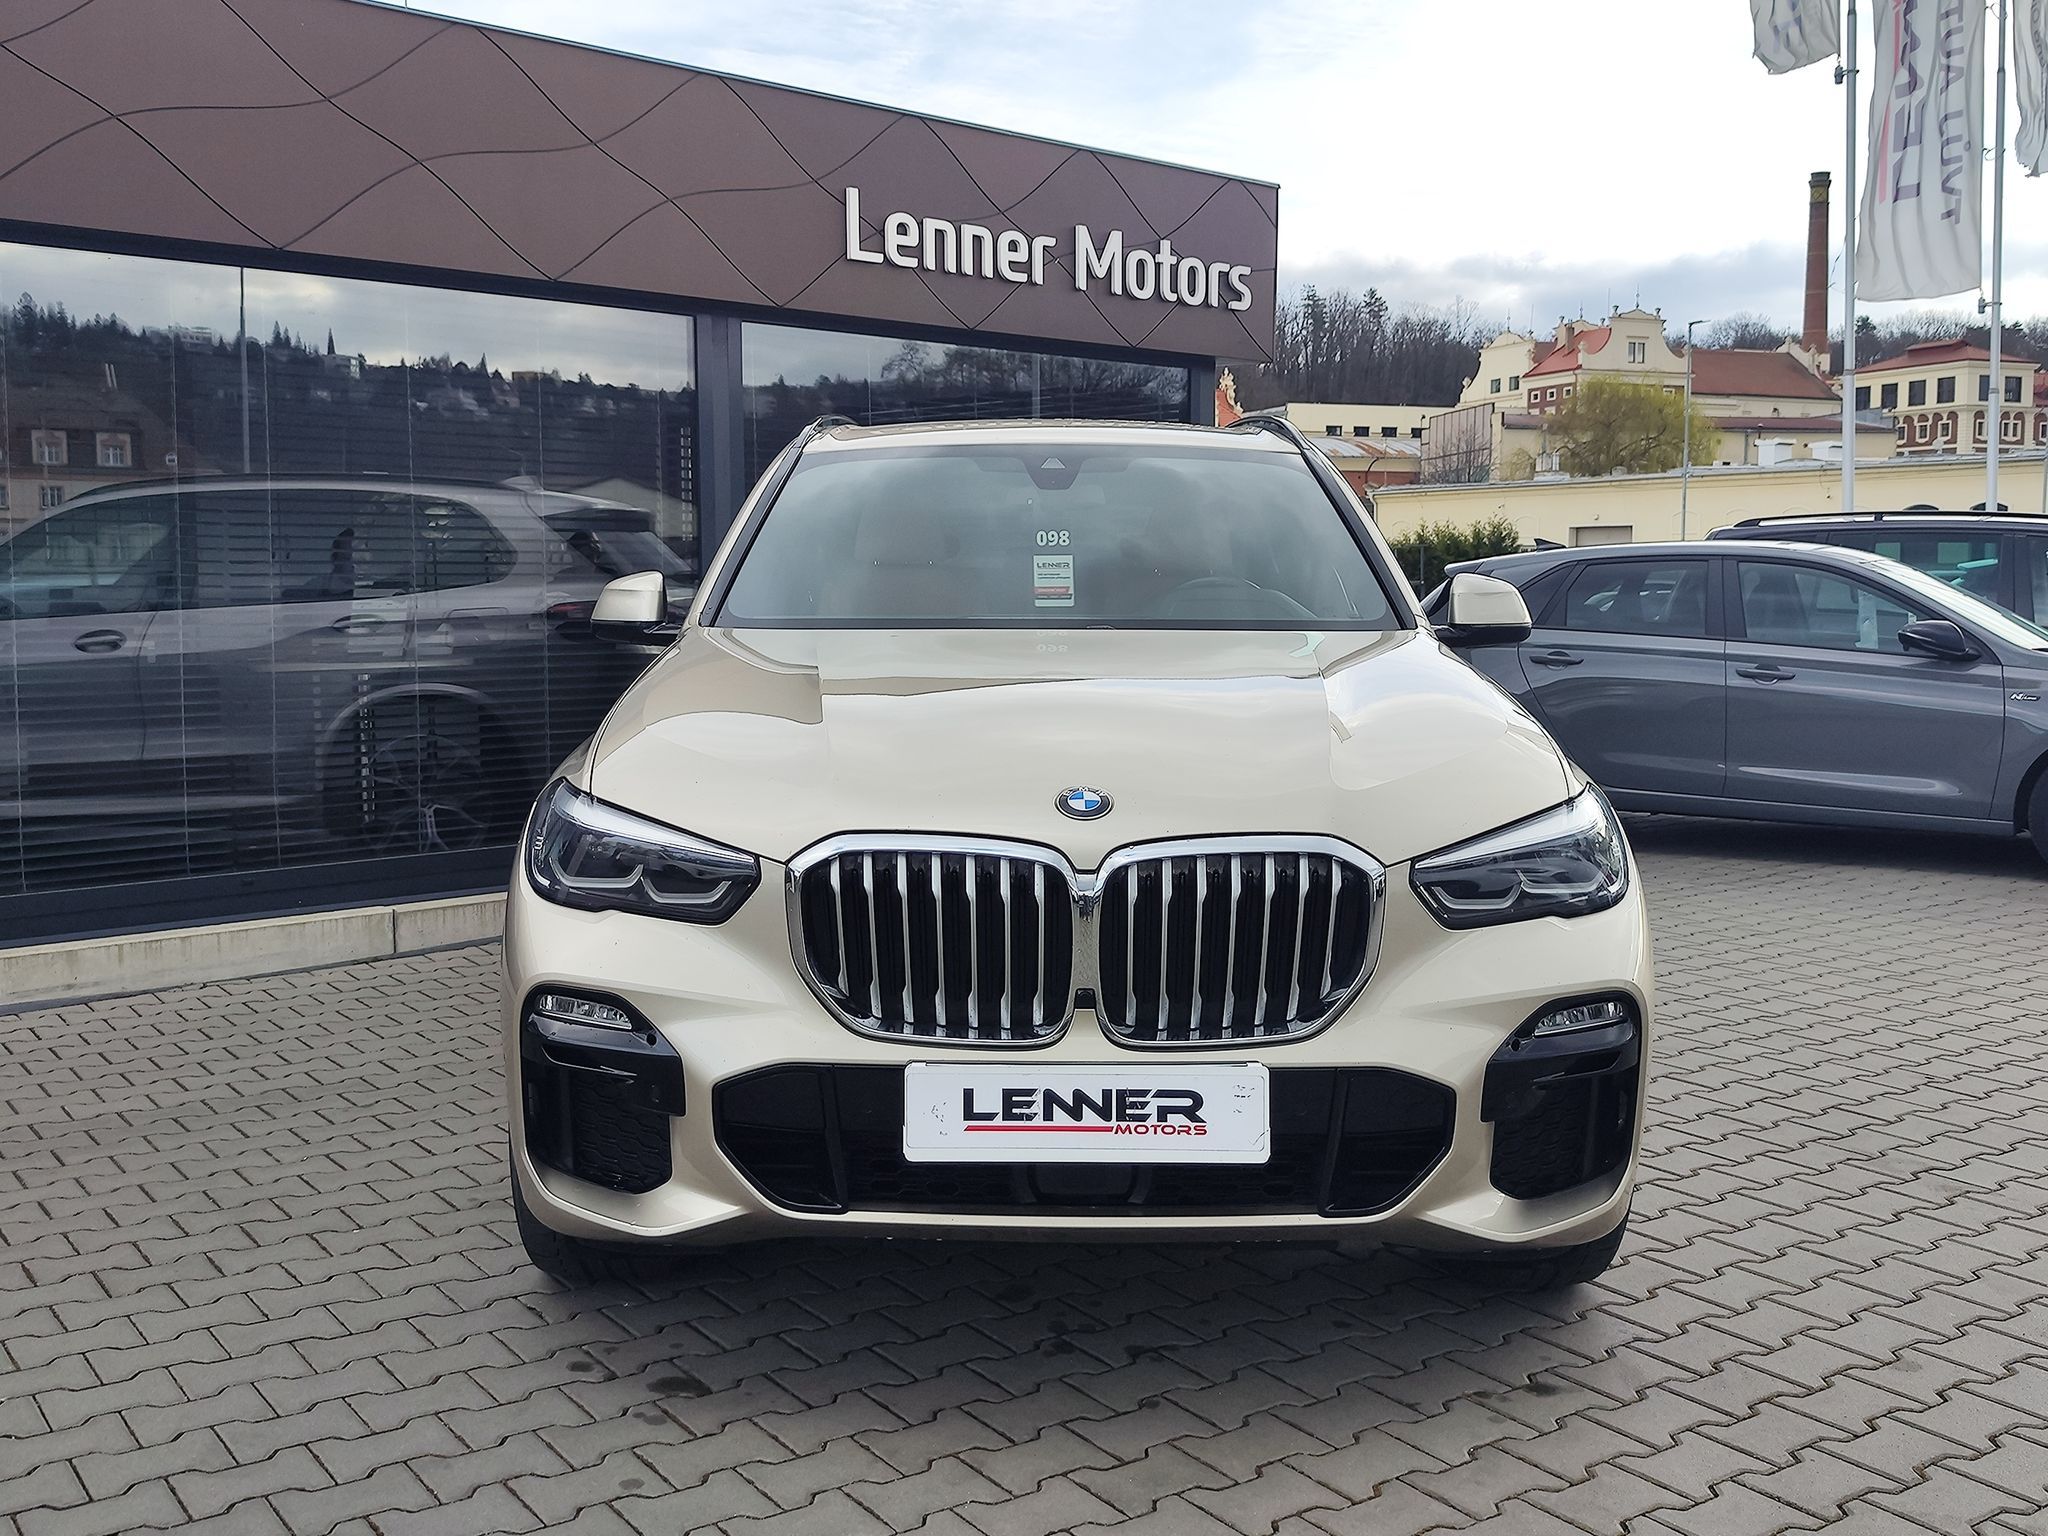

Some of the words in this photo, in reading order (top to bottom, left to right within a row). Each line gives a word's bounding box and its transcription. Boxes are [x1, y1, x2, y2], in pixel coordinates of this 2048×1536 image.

[844, 186, 1058, 286] Lenner
[1074, 224, 1252, 311] Motors
[1036, 530, 1070, 546] 098
[963, 1088, 1206, 1122] LENNER
[1114, 1124, 1208, 1136] MOTORS
